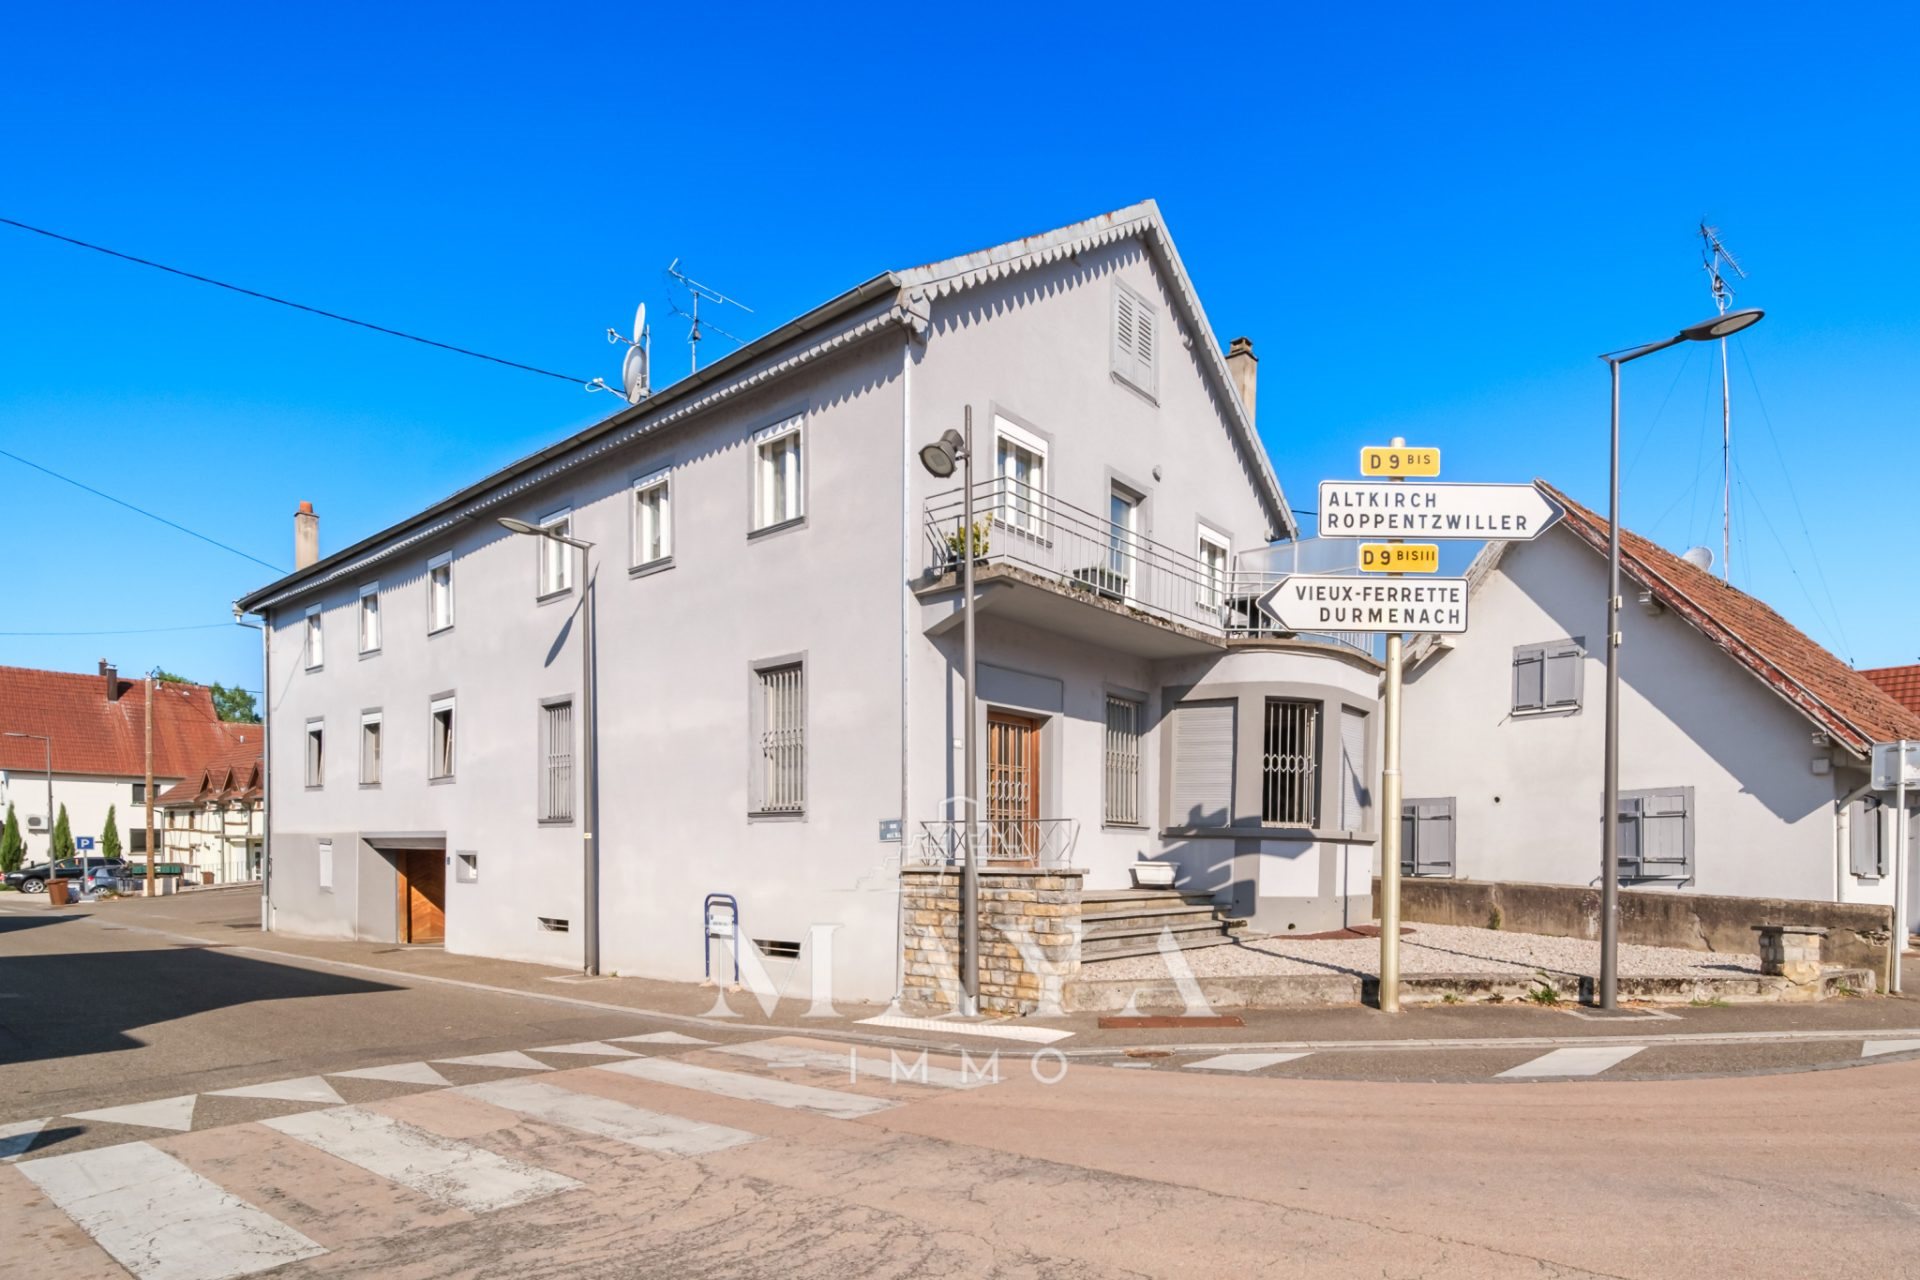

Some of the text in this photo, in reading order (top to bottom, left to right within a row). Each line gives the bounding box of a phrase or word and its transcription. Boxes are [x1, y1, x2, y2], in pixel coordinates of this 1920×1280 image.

[1370, 454, 1431, 469] D 9 BIS
[1328, 491, 1437, 508] ALTKIRCH
[1327, 513, 1528, 531] ROPPENTZWILLER
[1363, 550, 1435, 566] D 9 BISIII
[1295, 585, 1460, 603] VIEUX-FERRETTE
[1319, 607, 1460, 625] DURMENACH
[80, 838, 91, 848] P
